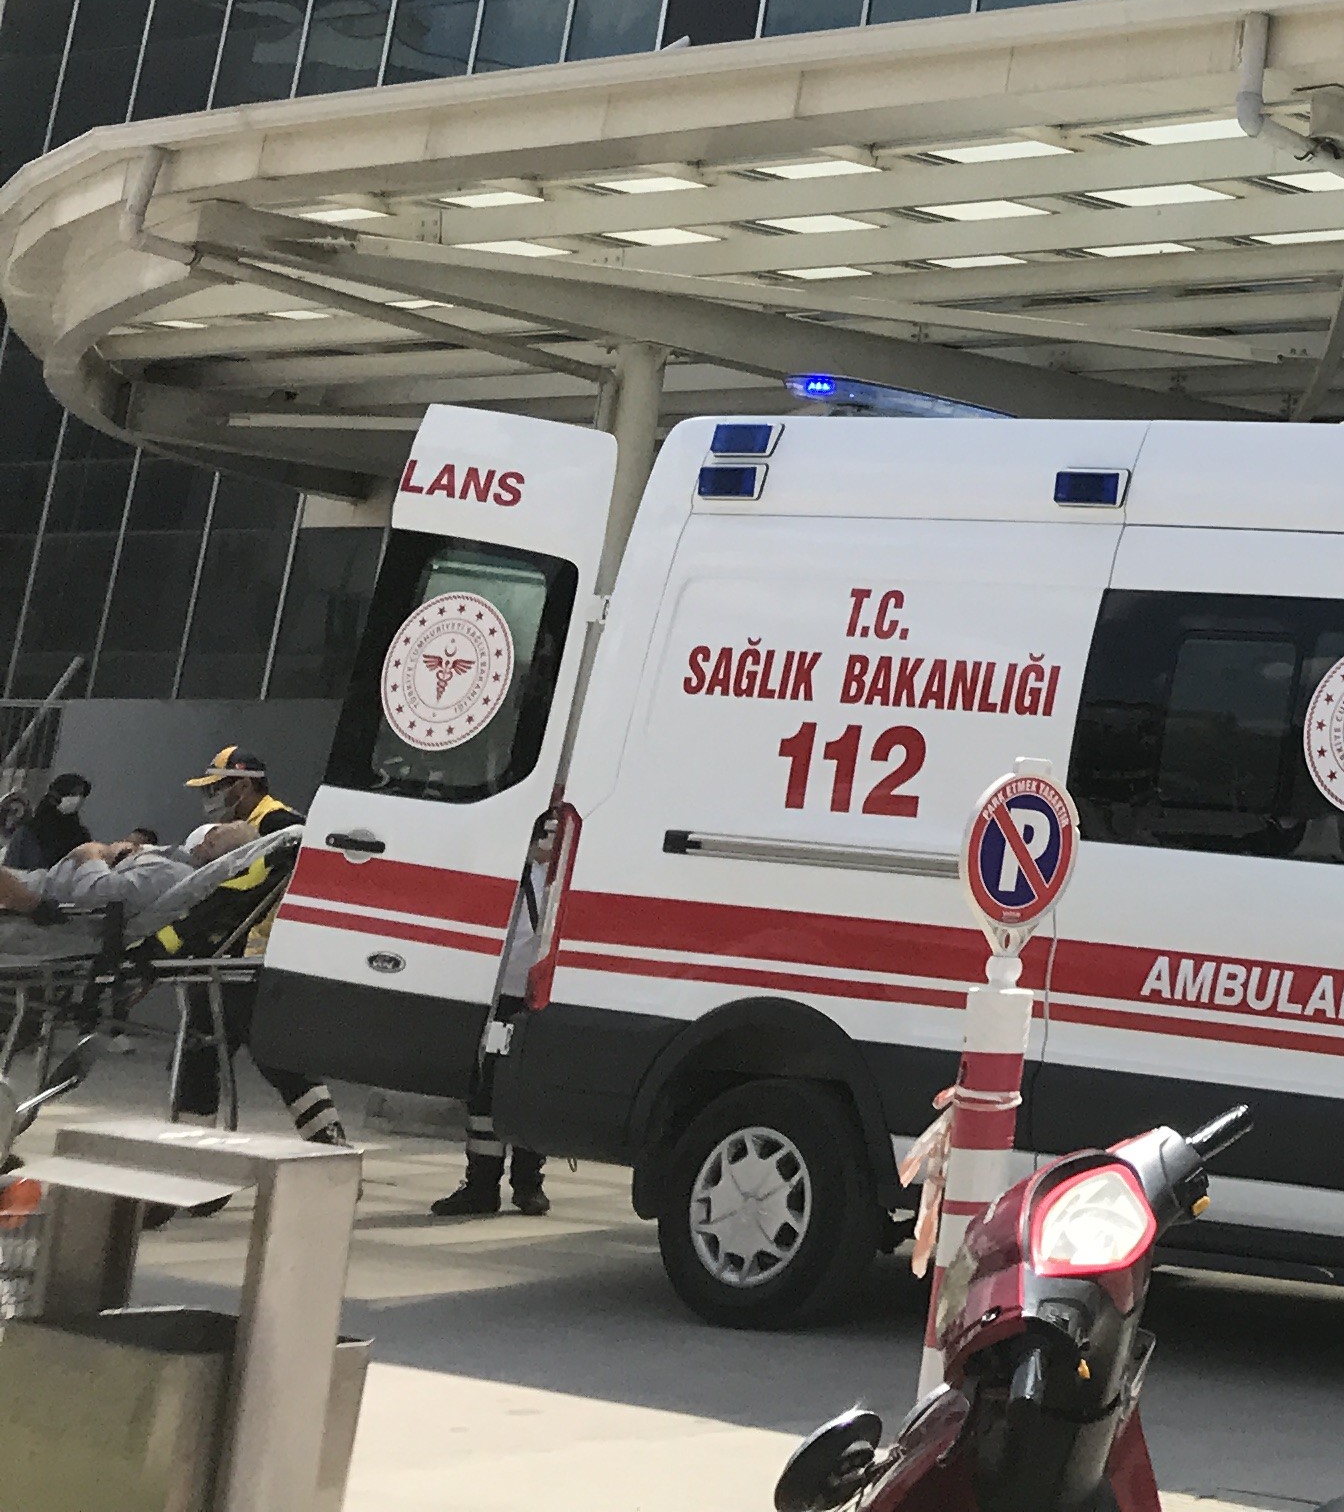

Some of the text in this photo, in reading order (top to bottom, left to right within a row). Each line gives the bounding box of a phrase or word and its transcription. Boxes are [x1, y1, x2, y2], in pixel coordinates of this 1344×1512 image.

[400, 459, 525, 507] LANS
[845, 588, 910, 641] T.C.
[682, 636, 1062, 717] SAĞLIK BAKANLIĞI
[777, 721, 928, 819] 112
[982, 790, 1006, 821] PARK
[1005, 779, 1038, 798] ETMEK
[998, 808, 1051, 893] P
